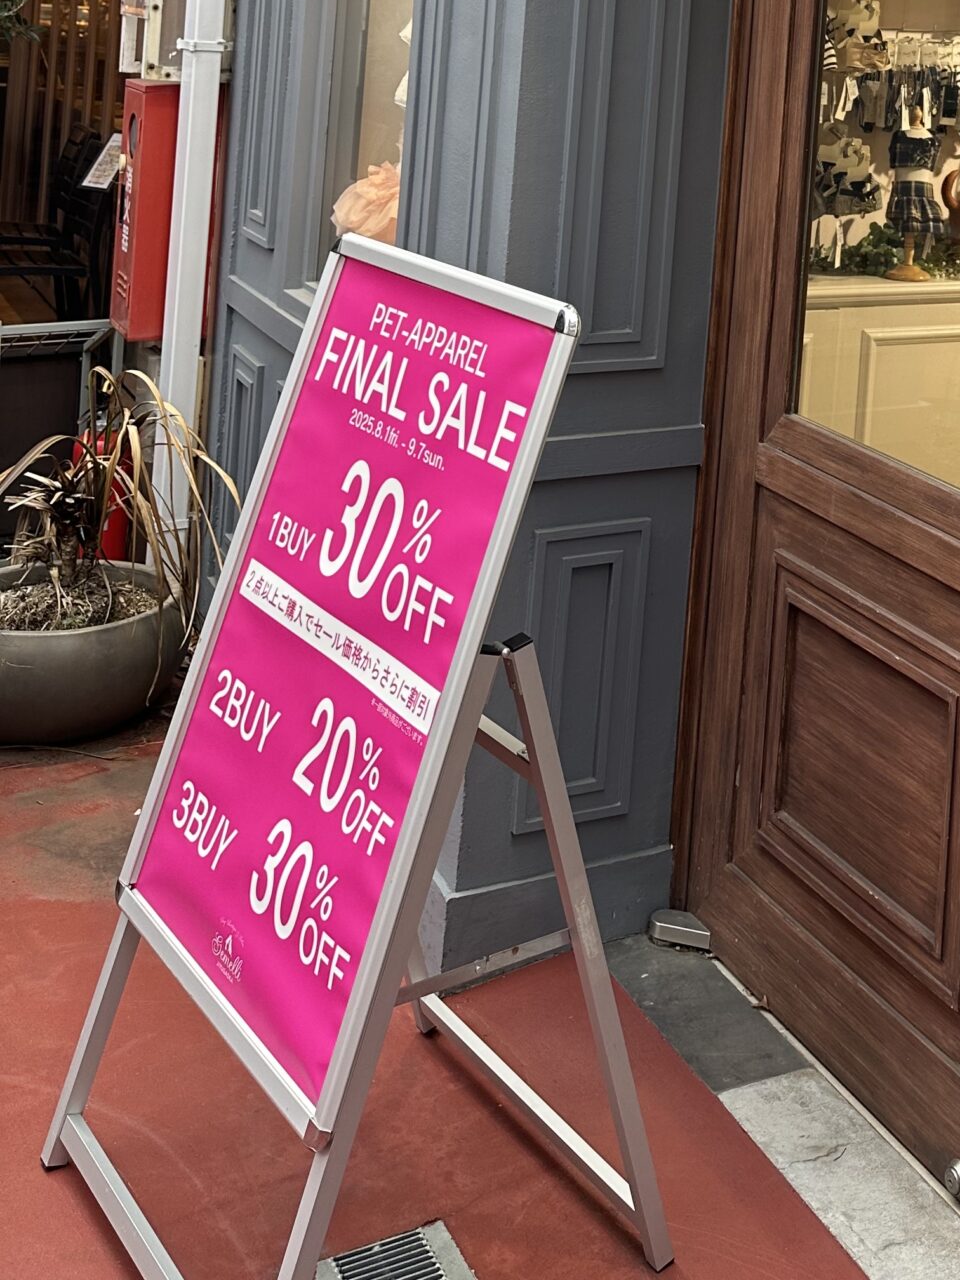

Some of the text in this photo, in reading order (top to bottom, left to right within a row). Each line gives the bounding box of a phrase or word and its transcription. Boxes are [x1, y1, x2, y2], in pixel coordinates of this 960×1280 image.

[314, 327, 528, 472] FINAL SALE
[369, 302, 488, 378] PET-APPAREL
[348, 408, 399, 449] 2025.8.1fri.
[406, 437, 446, 472] 9.7sun.
[268, 511, 317, 562] 1BUY
[381, 563, 455, 645] OFF
[209, 669, 282, 753] 2BUY
[341, 788, 395, 857] OFF
[172, 780, 239, 871] 3BUY
[298, 917, 351, 991] OFF
